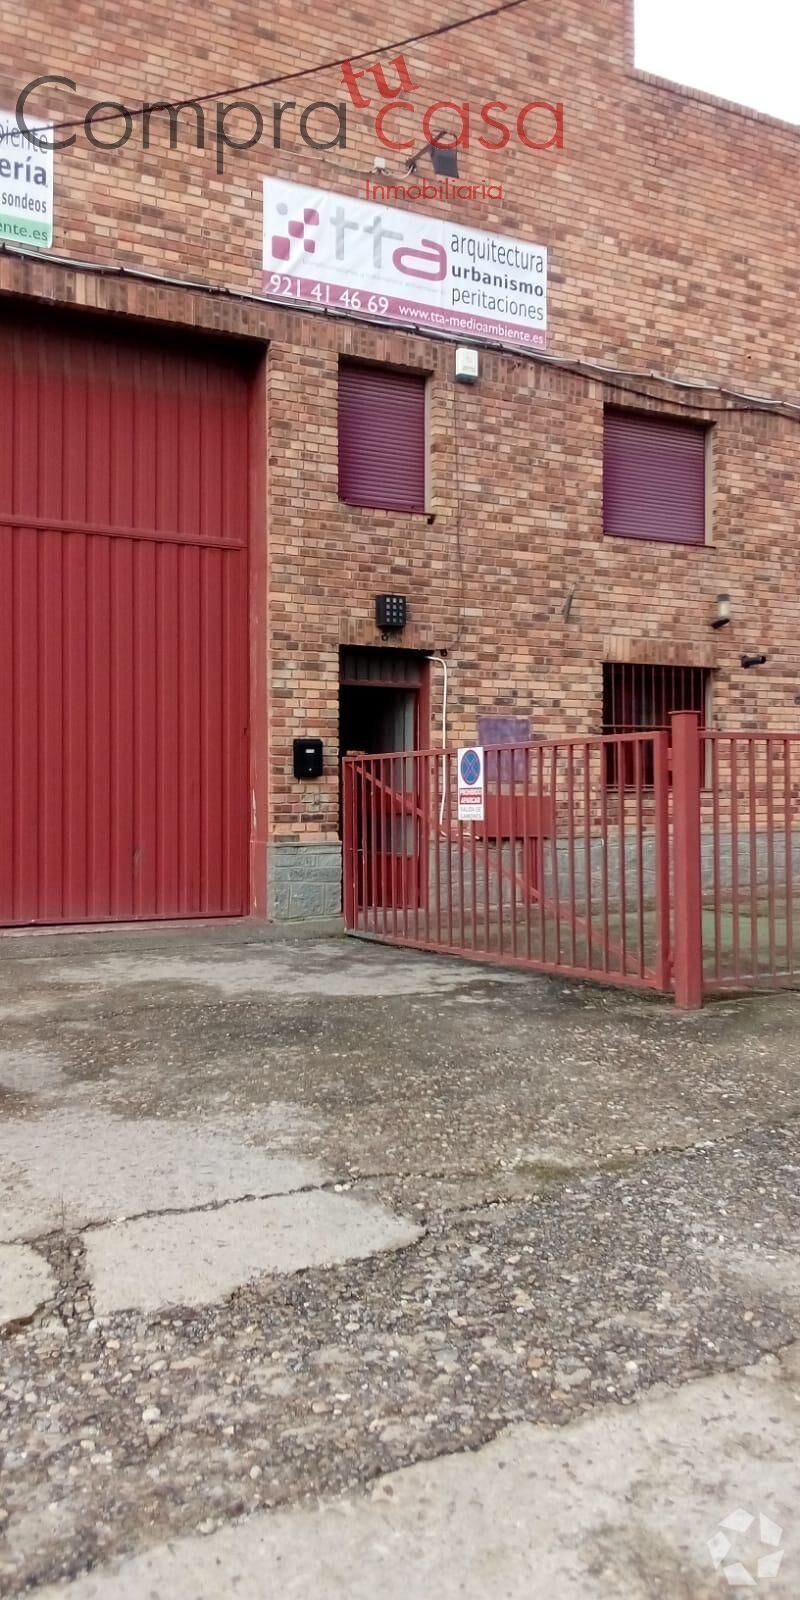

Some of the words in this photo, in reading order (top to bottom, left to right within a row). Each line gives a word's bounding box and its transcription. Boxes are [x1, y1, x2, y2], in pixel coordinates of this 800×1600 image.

[2, 191, 47, 214] sondeos
[329, 206, 448, 282] tta
[450, 233, 544, 273] arquitectura
[451, 264, 544, 297] urbanismo
[270, 274, 301, 298] 921
[310, 283, 330, 304] 41
[339, 288, 361, 309] 46
[367, 295, 389, 314] 69
[398, 304, 544, 345] www.tta-medioambiente.es
[451, 287, 544, 321] peritaciones
